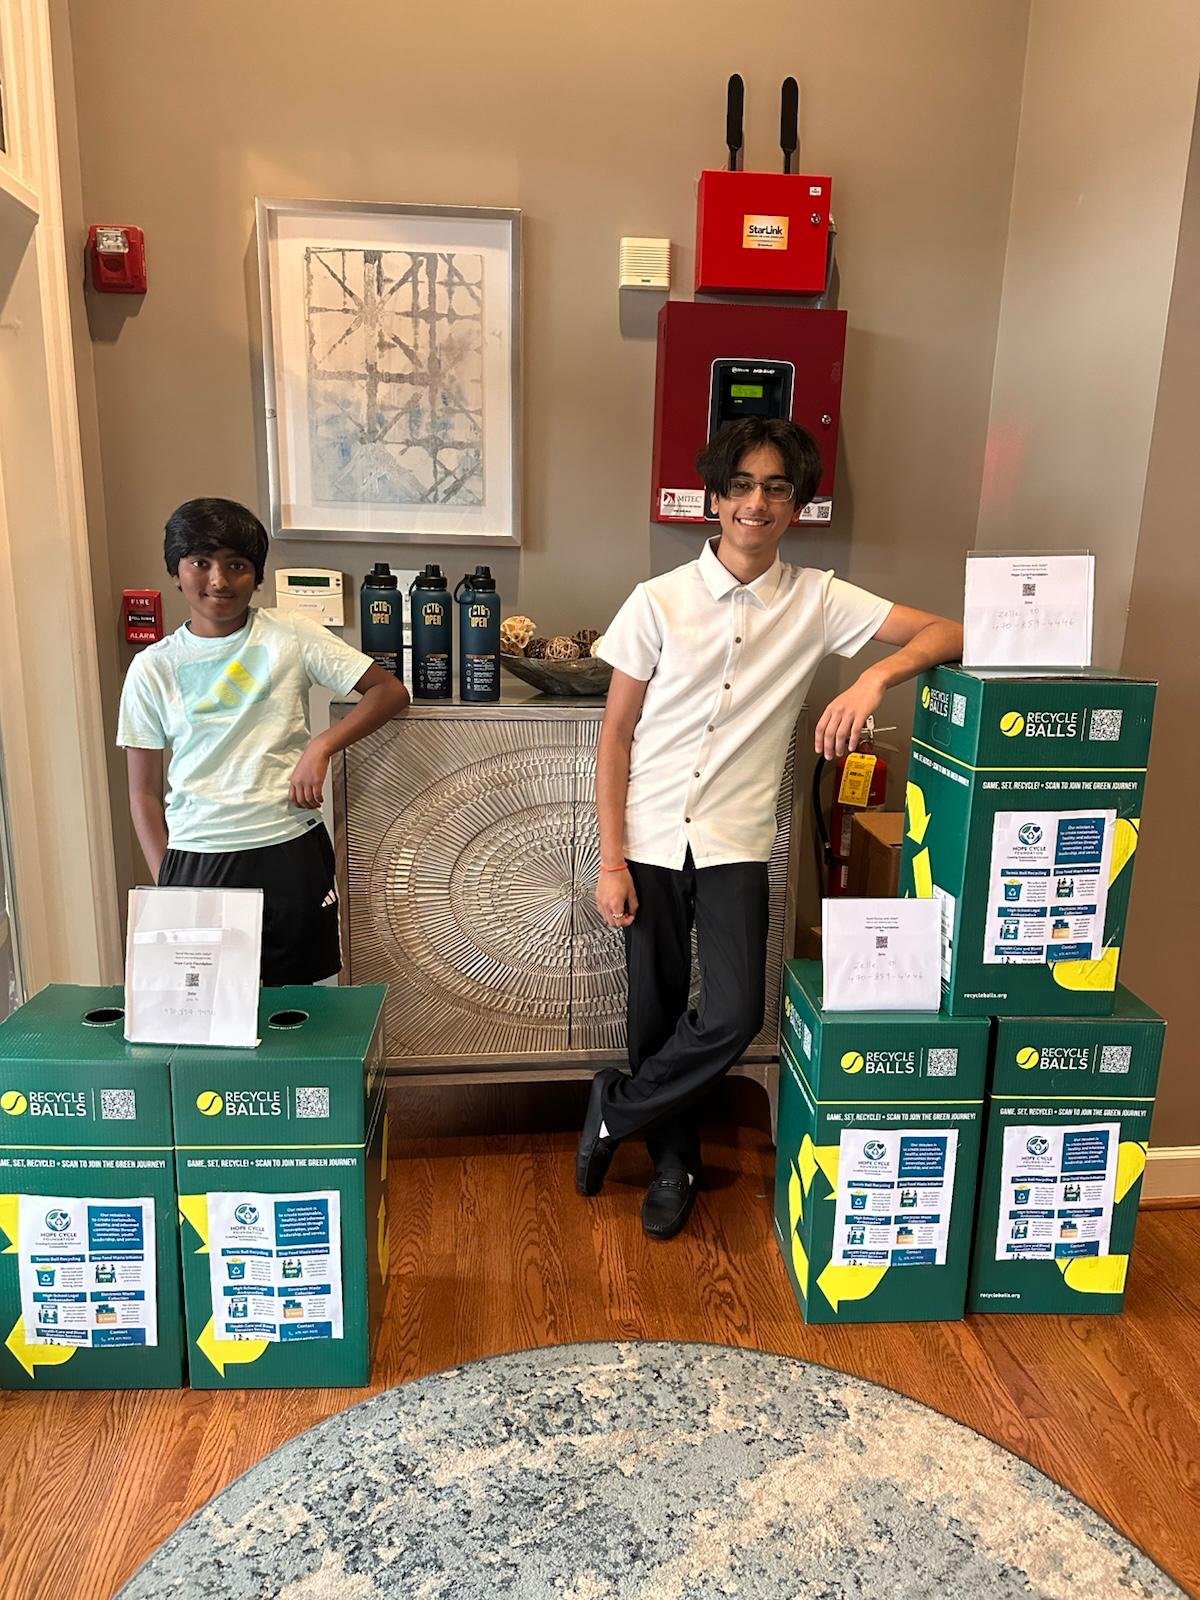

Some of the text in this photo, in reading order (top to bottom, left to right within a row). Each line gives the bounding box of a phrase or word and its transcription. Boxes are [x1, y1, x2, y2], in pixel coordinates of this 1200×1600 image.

[749, 225, 783, 235] StarLink
[130, 598, 150, 606] FIRE
[930, 699, 948, 718] BALLS
[1026, 712, 1078, 723] RECYCLE
[1025, 723, 1076, 737] BALLS
[1045, 781, 1060, 790] SCAN
[1060, 781, 1069, 790] TO
[1069, 781, 1081, 790] JOIN
[1082, 781, 1092, 790] THE
[1092, 781, 1110, 790] GREEN
[1111, 782, 1138, 790] JOURNEY!
[866, 1052, 914, 1062] RECYCLE
[1041, 1048, 1090, 1058] RECYCLE
[866, 1062, 914, 1074] BALLS
[1040, 1058, 1088, 1070] BALLS
[29, 1091, 86, 1103] RECYCLE
[225, 1091, 280, 1102] RECYCLE
[30, 1102, 87, 1116] BALLS
[226, 1102, 282, 1116] BALLS
[1058, 1108, 1074, 1116] SCAN
[1074, 1108, 1081, 1116] TO
[1081, 1108, 1092, 1116] JOIN
[1093, 1109, 1103, 1117] THE
[1104, 1109, 1120, 1117] GREEN
[1121, 1109, 1147, 1117] JOURNEY!
[886, 1113, 902, 1121] SCAN
[902, 1113, 909, 1121] TO
[909, 1113, 921, 1121] JOIN
[921, 1113, 932, 1121] THE
[932, 1113, 950, 1121] GREEN
[950, 1113, 976, 1121] JOURNEY!
[61, 1159, 79, 1168] SCAN
[79, 1160, 88, 1168] TO
[88, 1160, 102, 1168] JOIN
[102, 1160, 114, 1168] THE
[114, 1160, 136, 1168] GREEN
[136, 1160, 166, 1168] JOURNEY!
[254, 1159, 272, 1168] SCAN
[272, 1159, 281, 1167] TO
[281, 1158, 294, 1167] JOIN
[294, 1158, 308, 1167] THE
[308, 1158, 328, 1166] GREEN
[328, 1158, 357, 1166] JOURNEY!
